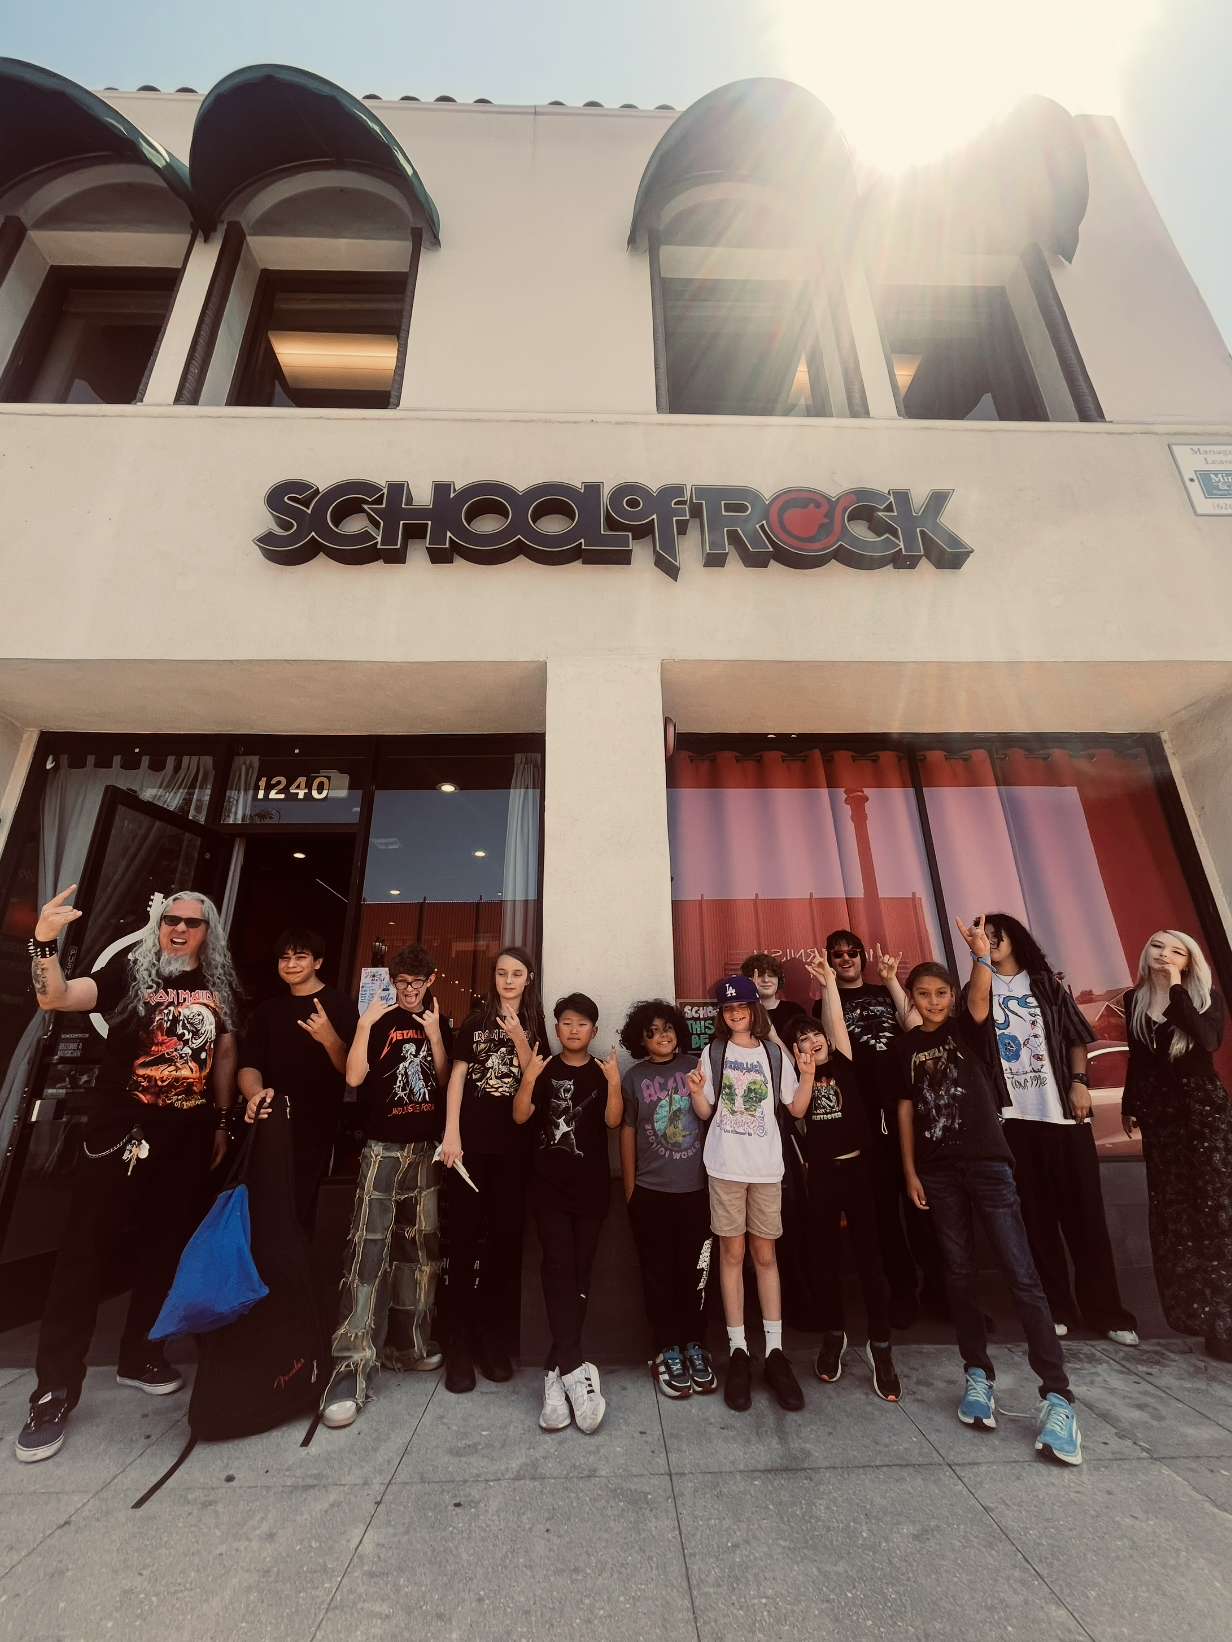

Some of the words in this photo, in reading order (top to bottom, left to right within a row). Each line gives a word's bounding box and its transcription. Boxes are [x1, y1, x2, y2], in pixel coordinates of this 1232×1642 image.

[252, 479, 633, 566] SCHOOL
[604, 482, 691, 583] of
[690, 485, 976, 570] ROCK
[257, 775, 330, 800] 1240
[65, 949, 76, 976] PUSH
[147, 988, 178, 1006] RON
[177, 989, 216, 1006] MAID
[725, 983, 737, 997] LA
[686, 1020, 716, 1035] THIS
[378, 1026, 428, 1060] METALLI
[640, 1071, 691, 1104] AC/D
[672, 1140, 701, 1160] WORLD
